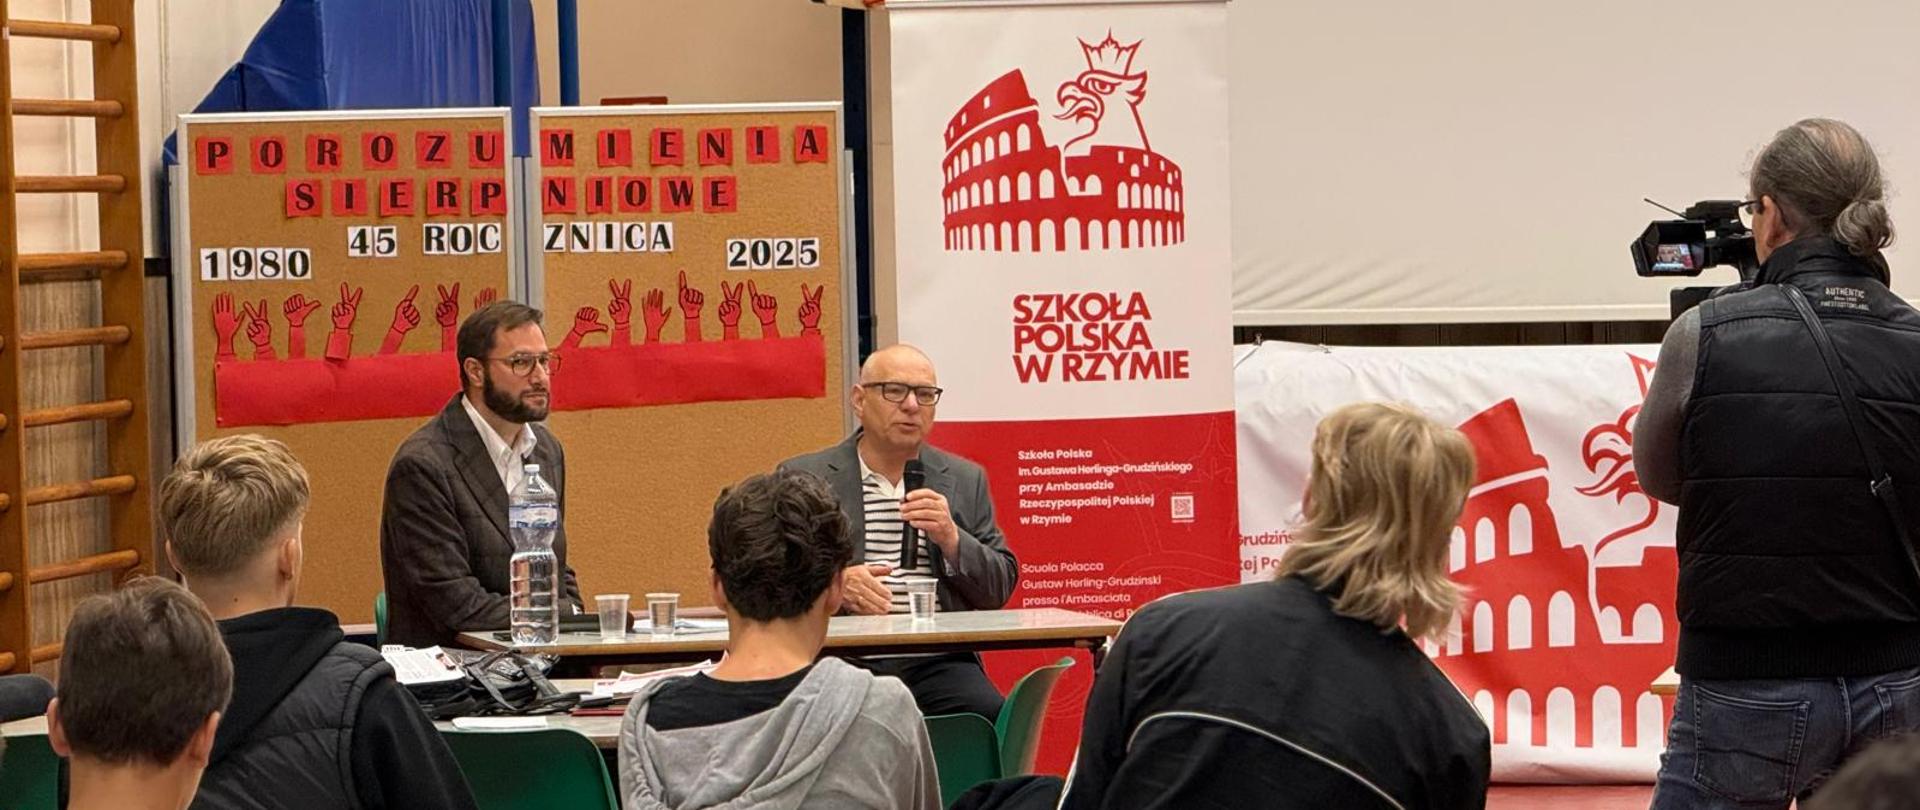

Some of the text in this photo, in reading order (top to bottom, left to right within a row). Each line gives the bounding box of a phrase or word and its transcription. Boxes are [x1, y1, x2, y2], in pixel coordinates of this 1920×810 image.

[350, 227, 396, 255] 45
[728, 239, 819, 268] 2025
[204, 250, 310, 279] 1980
[1013, 292, 1152, 323] SZKOŁA
[1014, 322, 1153, 353] POLSKA
[1012, 350, 1190, 383] W RZYMIE
[1018, 449, 1093, 460] Szkoła Polska
[1032, 465, 1077, 476] Gustawa
[1019, 479, 1115, 495] przy Ambasadzie
[1019, 493, 1155, 510] Rzeczypospolitej Polskiej
[1020, 513, 1073, 526] w Rzymie
[1021, 561, 1105, 574] Scuola Polacca
[1022, 578, 1064, 590] Gustaw
[1022, 597, 1060, 608] presso
